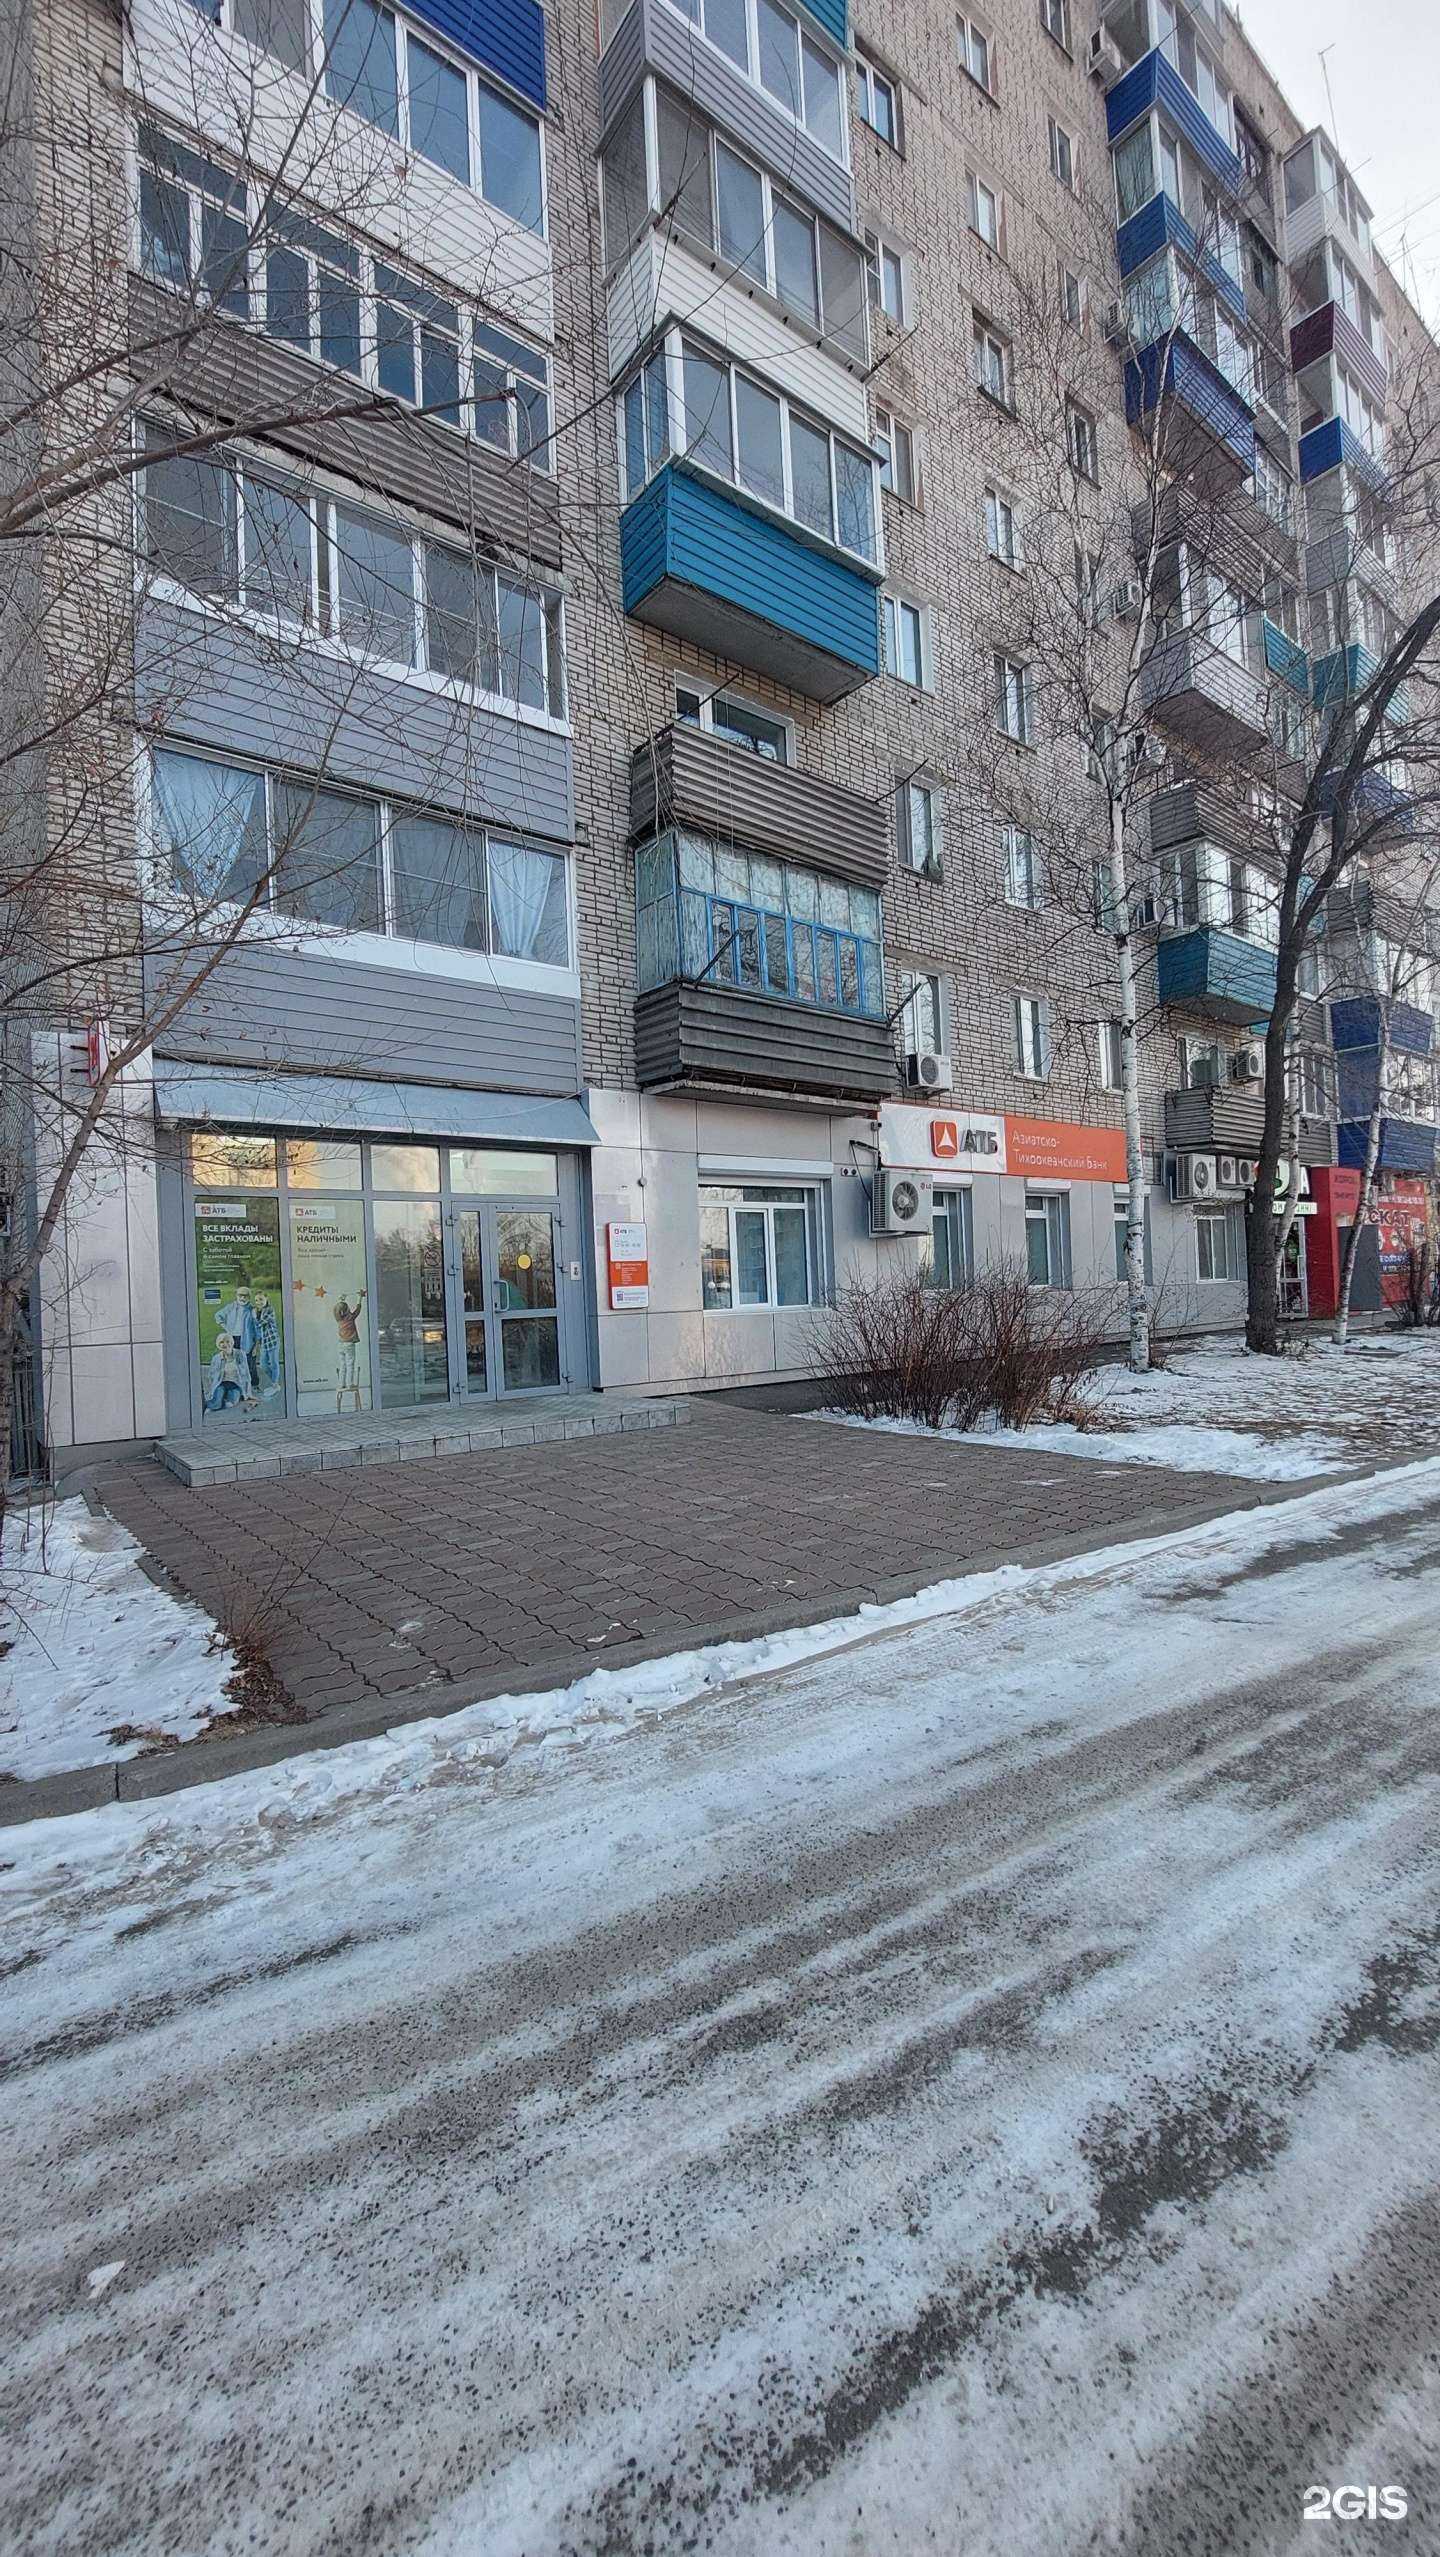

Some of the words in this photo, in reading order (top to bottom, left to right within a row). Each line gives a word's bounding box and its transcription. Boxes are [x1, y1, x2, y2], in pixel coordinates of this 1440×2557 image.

[960, 1128, 999, 1155] АТБ
[1011, 1130, 1061, 1148] Азиатско-
[1013, 1148, 1085, 1170] Тихоокеанский
[1086, 1155, 1109, 1170] Банк
[212, 1207, 226, 1215] АТБ
[304, 1208, 318, 1216] АТБ
[220, 1224, 258, 1233] ВКЛАДЫ
[296, 1225, 339, 1234] КРЕДИТЫ
[202, 1235, 273, 1243] ЗАСТРАХОВАНЫ
[297, 1235, 357, 1243] НАЛИЧНЫМИ
